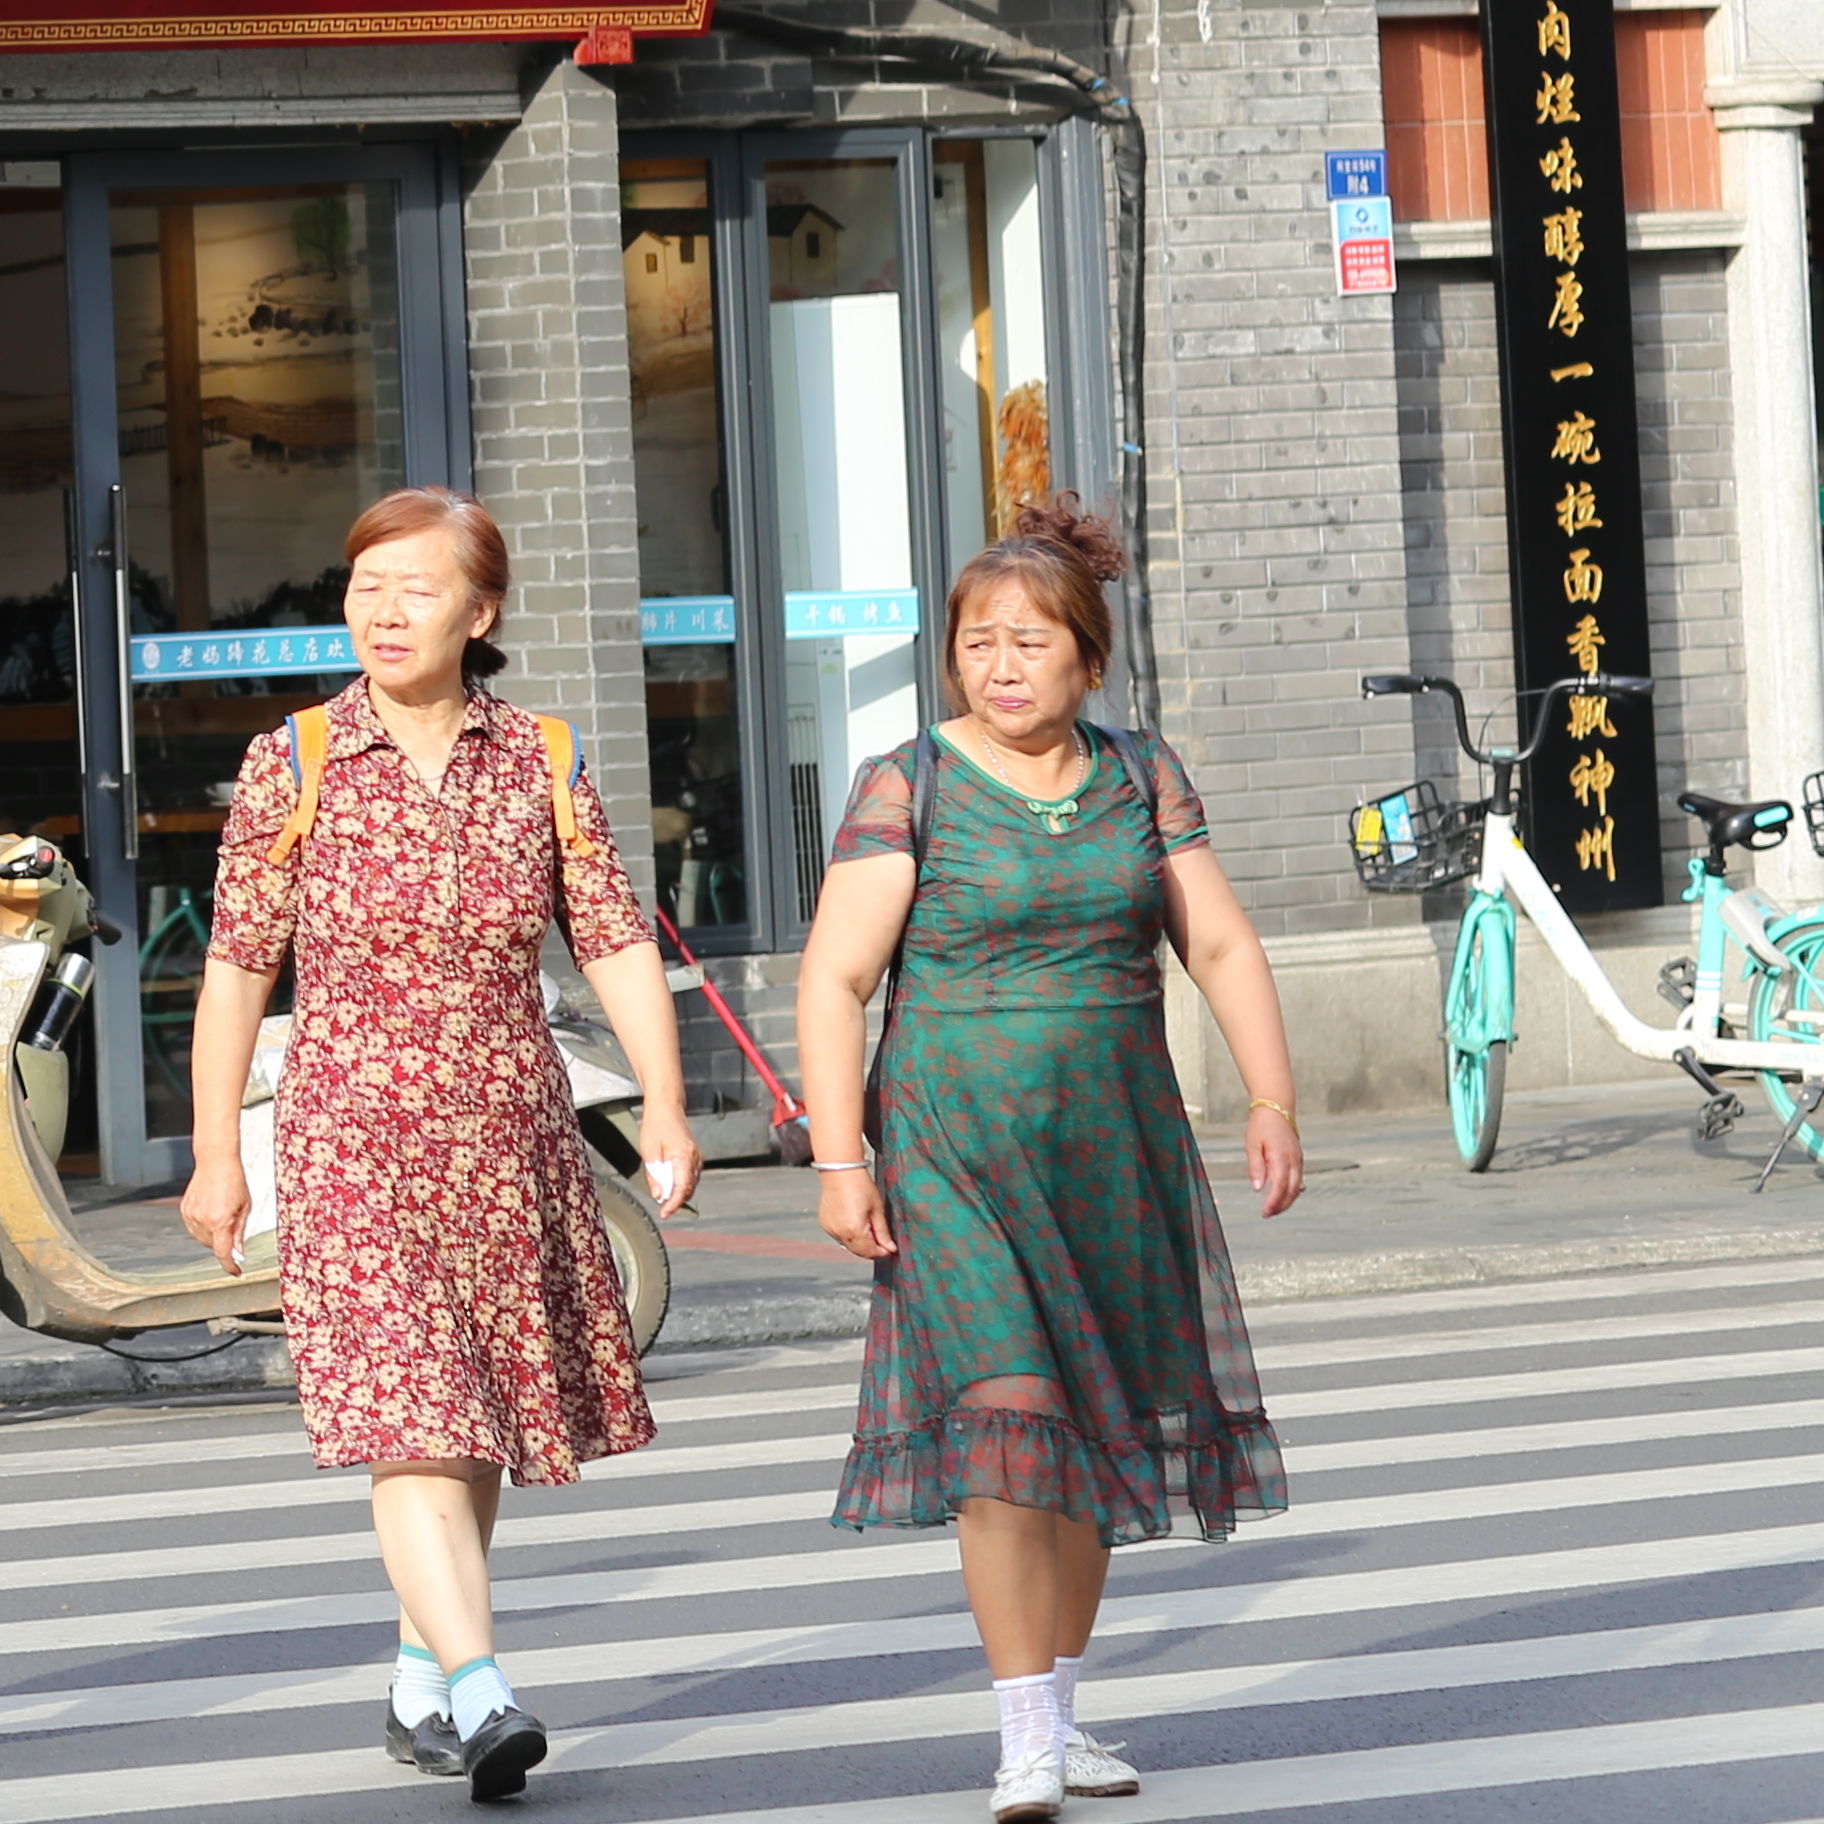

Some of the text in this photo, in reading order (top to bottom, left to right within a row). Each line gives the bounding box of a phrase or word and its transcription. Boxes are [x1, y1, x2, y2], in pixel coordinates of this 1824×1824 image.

[176, 638, 357, 668] 老妈蹄花总店欢
